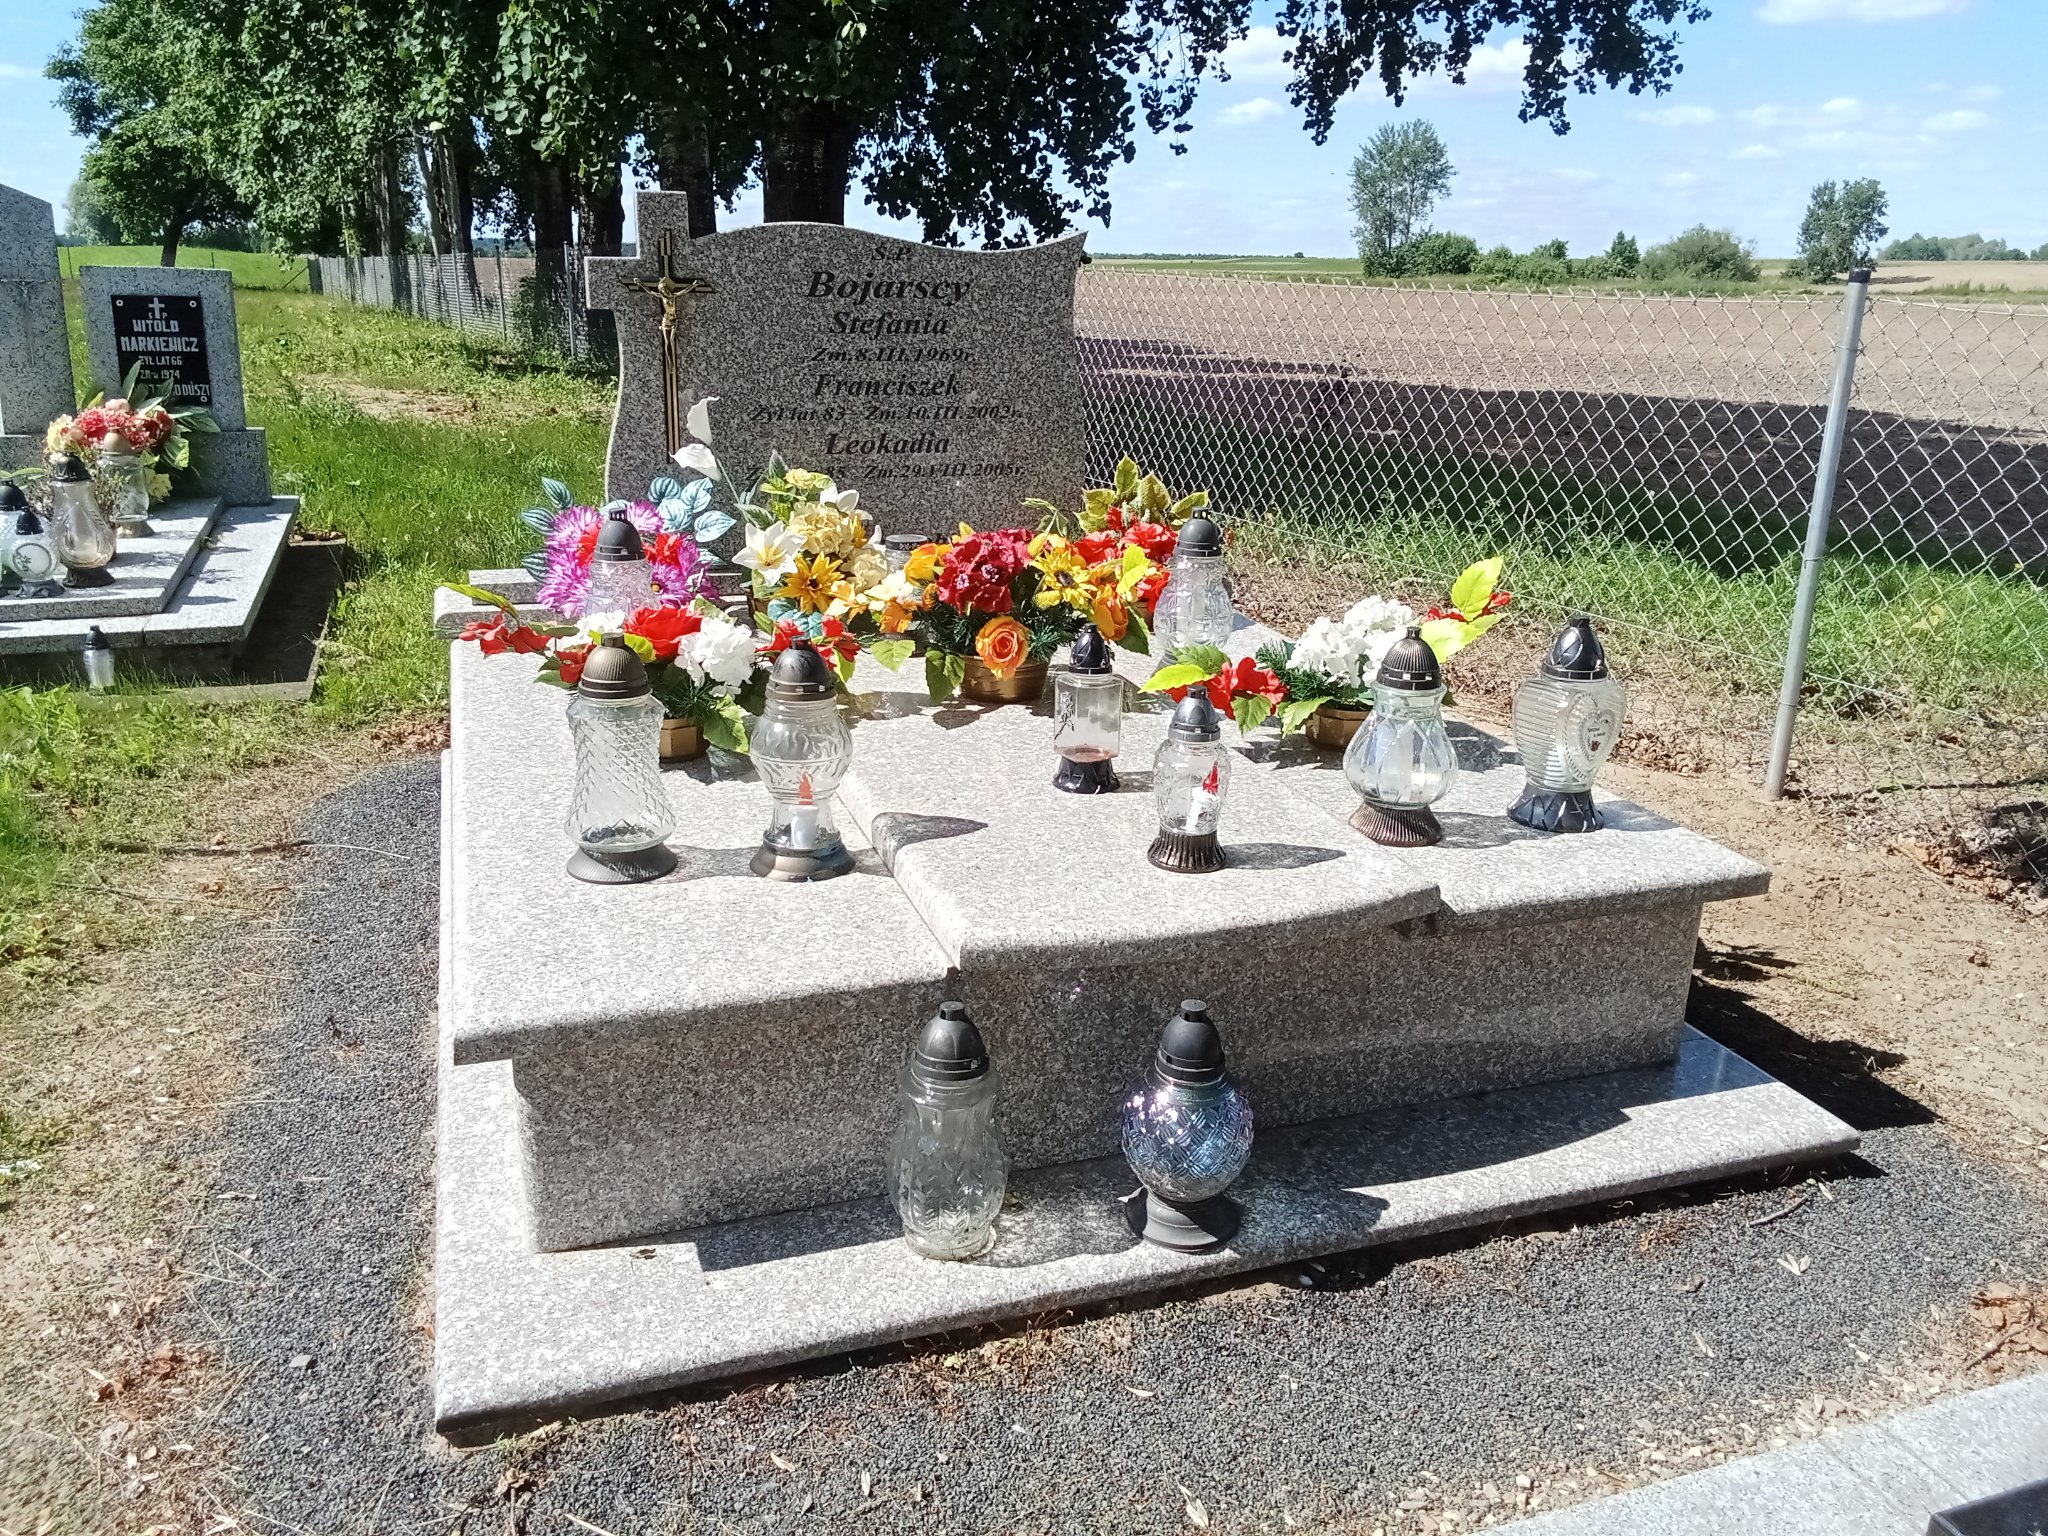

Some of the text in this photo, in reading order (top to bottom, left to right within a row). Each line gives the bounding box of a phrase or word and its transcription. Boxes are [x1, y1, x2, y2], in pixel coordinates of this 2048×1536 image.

[806, 270, 971, 306] Bojarscy
[132, 319, 180, 332] WITOLD
[829, 311, 949, 340] Stefania
[120, 336, 199, 352] MARKIEWICZ
[156, 355, 170, 366] LAT
[814, 373, 961, 397] Franciszek
[825, 431, 950, 455] Leokadia
